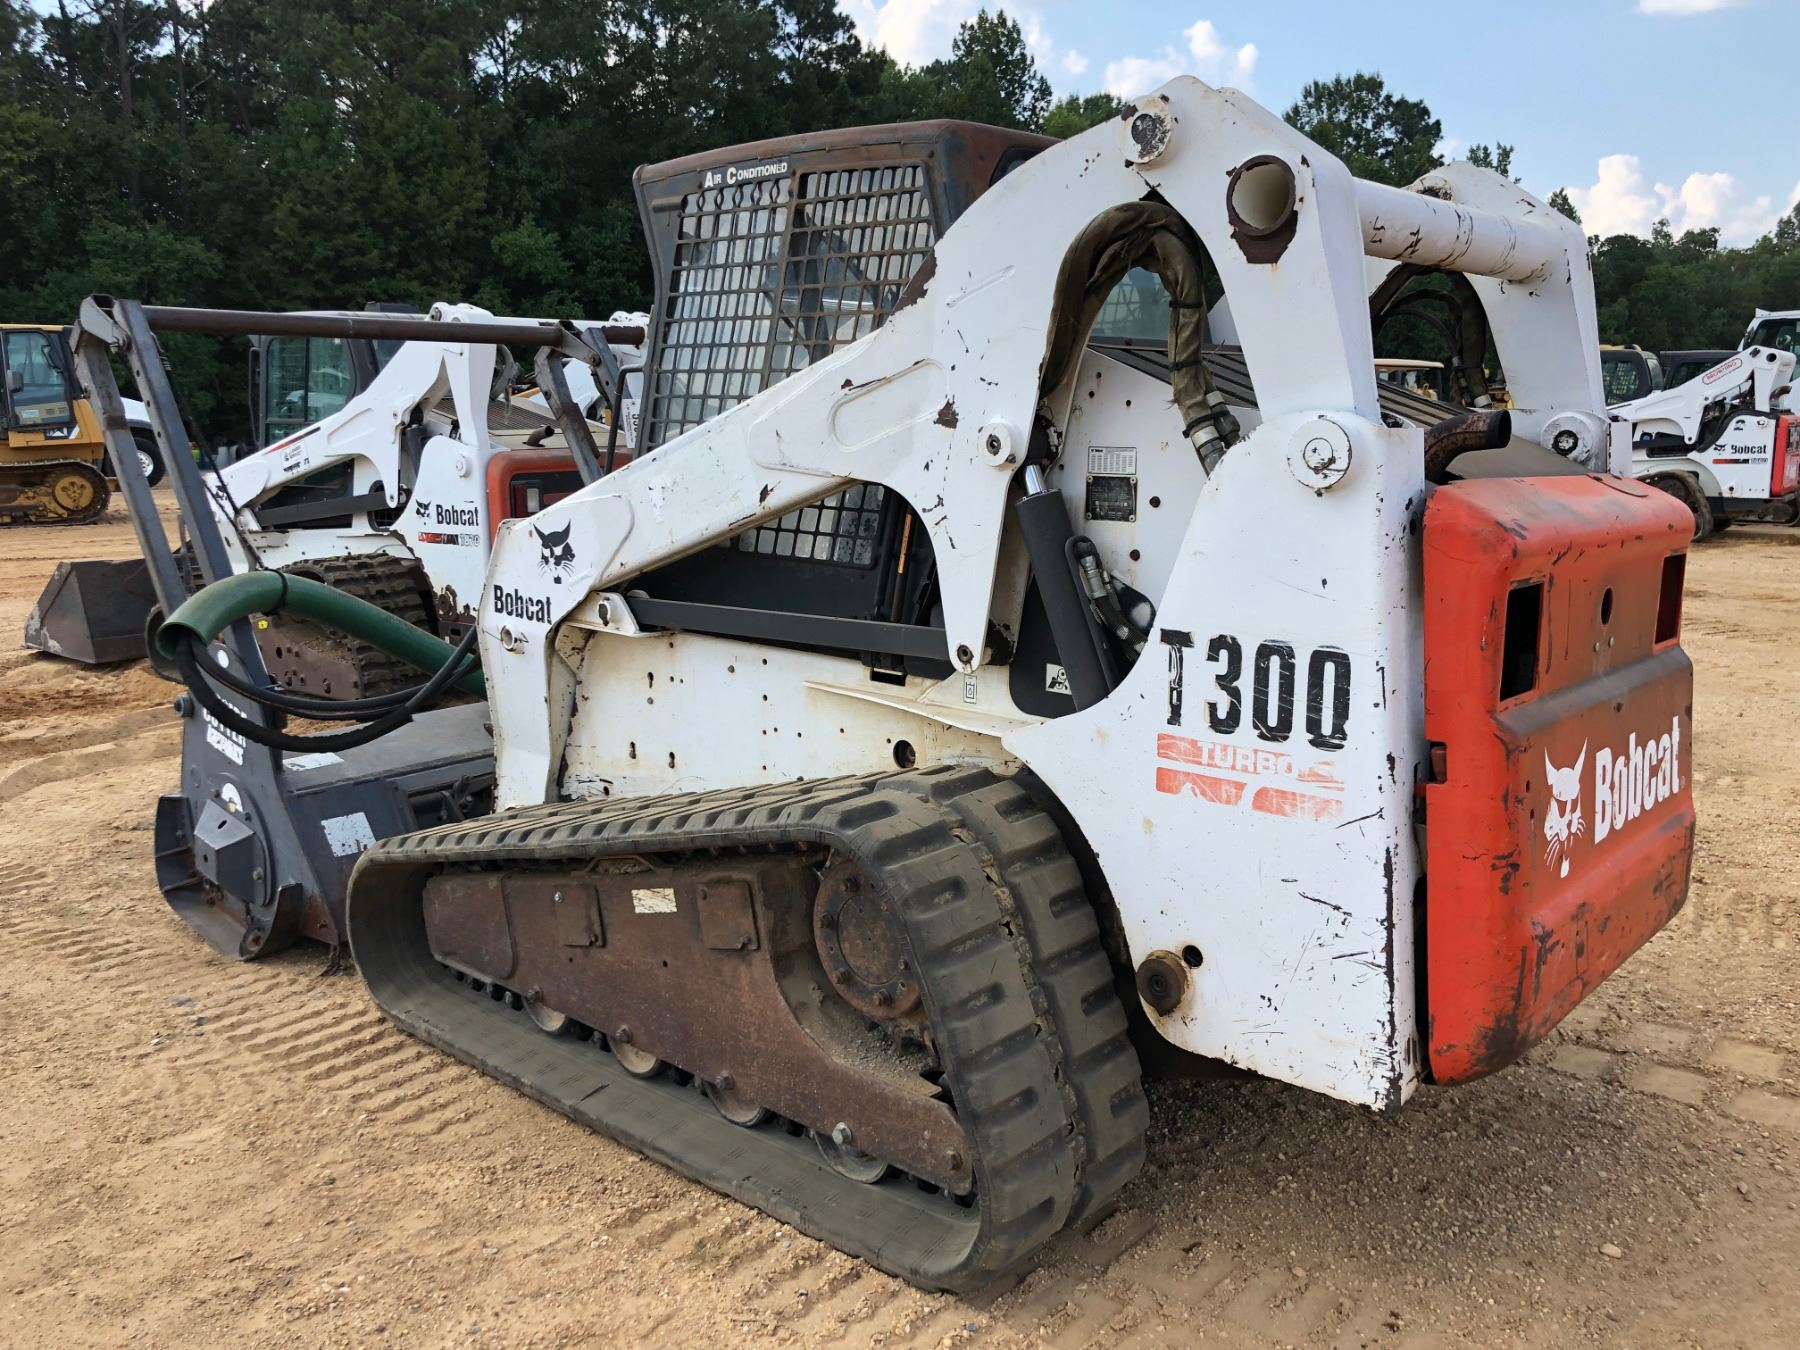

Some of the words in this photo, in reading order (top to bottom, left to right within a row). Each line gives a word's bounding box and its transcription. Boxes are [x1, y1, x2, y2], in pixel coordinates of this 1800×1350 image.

[1730, 444, 1767, 454] Bobcat
[436, 504, 479, 526] Bobcat
[494, 584, 552, 625] Bobcat
[1159, 628, 1351, 752] T300
[1197, 740, 1294, 776] TURBO
[1594, 715, 1680, 845] Bobcat
